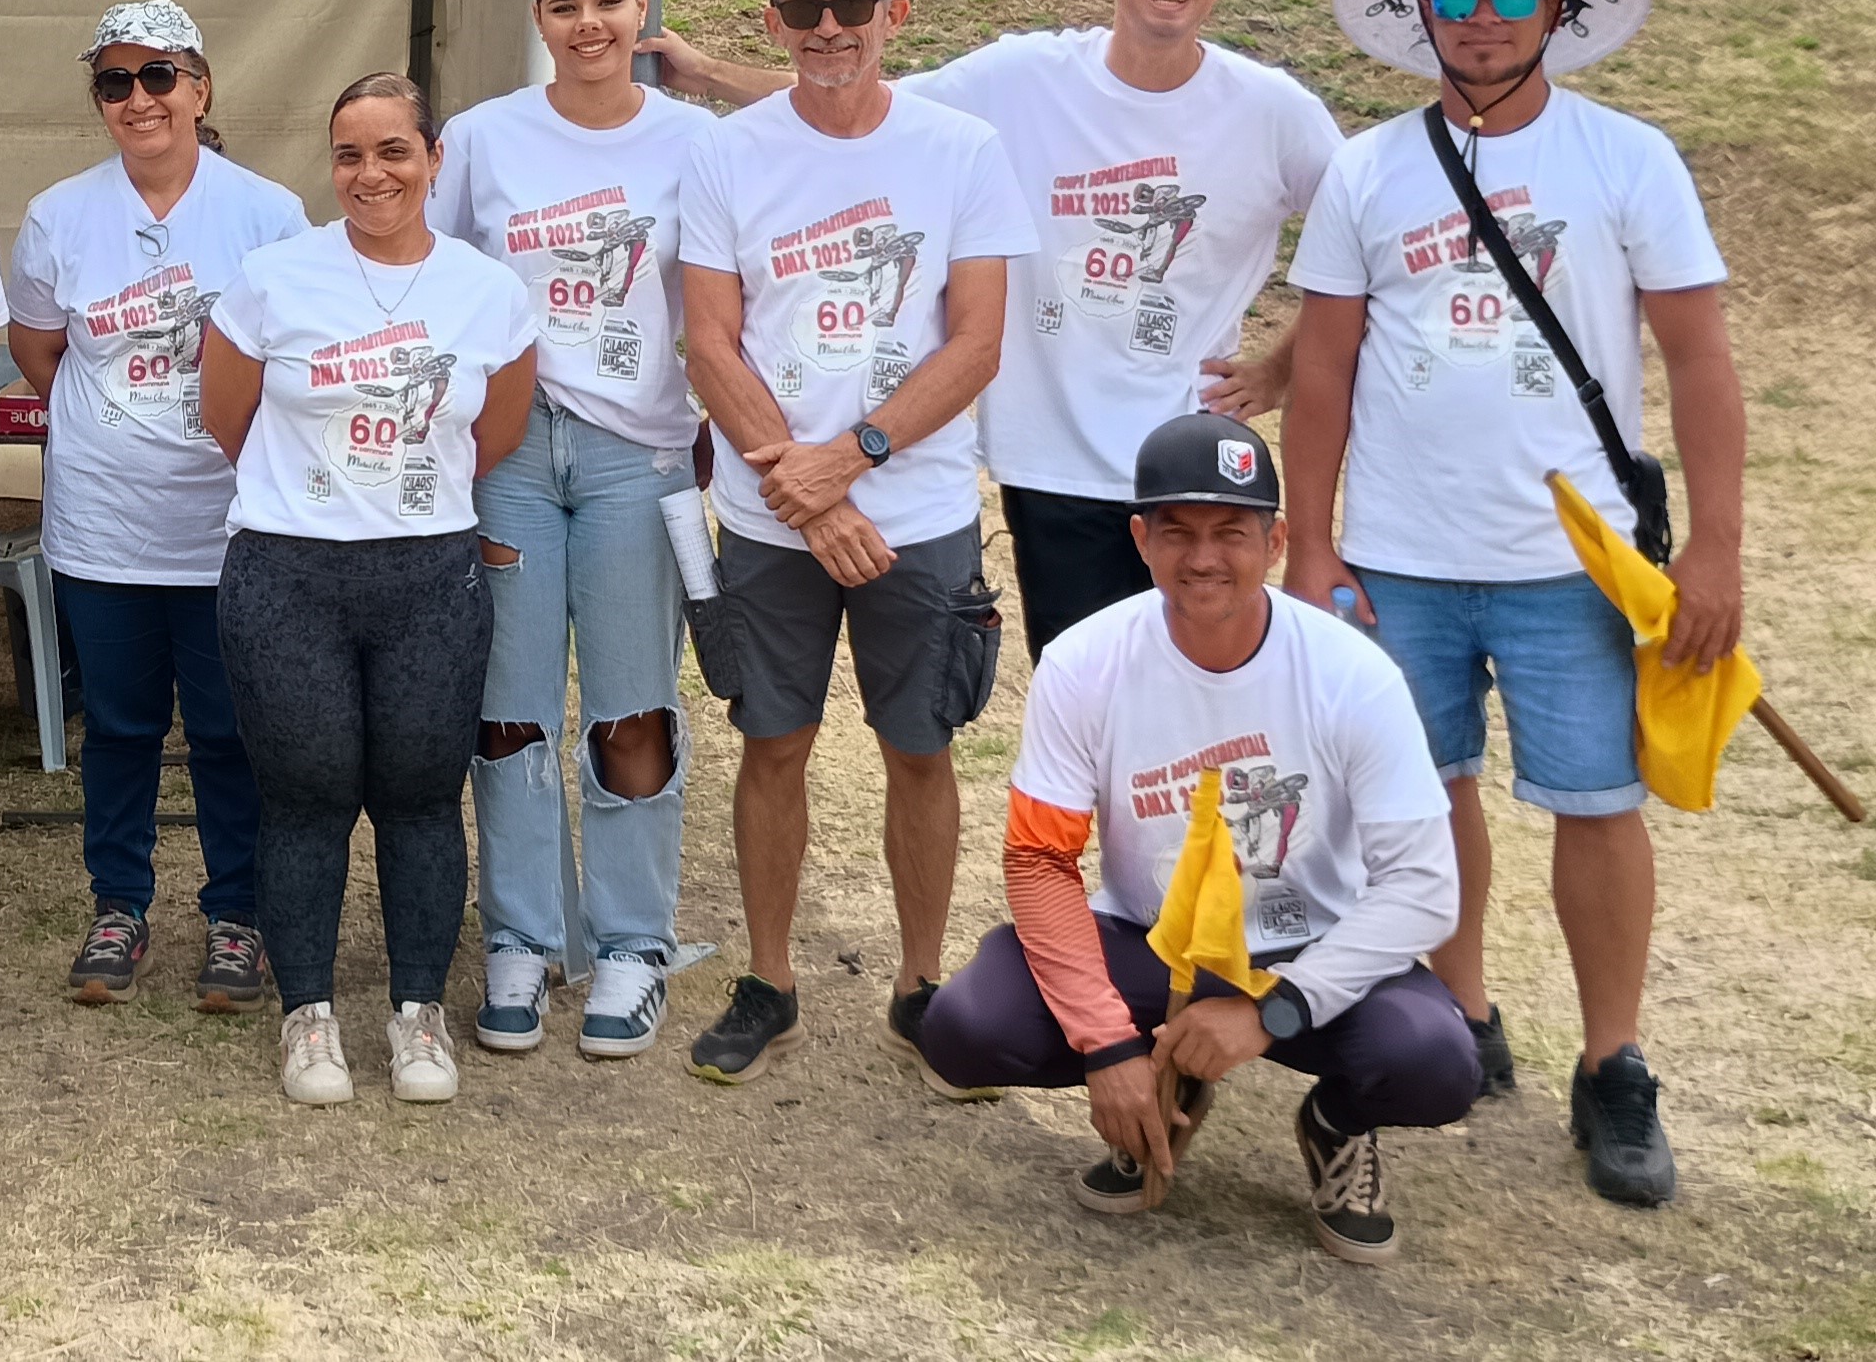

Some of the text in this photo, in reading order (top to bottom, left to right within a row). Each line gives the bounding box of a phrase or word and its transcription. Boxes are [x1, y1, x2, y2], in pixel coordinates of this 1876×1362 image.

[1054, 174, 1086, 189] COUPE
[508, 209, 538, 228] COUPE
[1051, 193, 1131, 216] BMX 2025
[507, 222, 585, 254] BMX 2025
[771, 229, 802, 251] COUPE
[1403, 222, 1434, 246] COUPE
[771, 240, 854, 279] BMX 2025
[1085, 247, 1133, 279] 60
[1404, 242, 1443, 274] BMX
[88, 294, 116, 312] COUPE
[549, 278, 594, 307] 60
[86, 303, 157, 337] BMX 2025
[817, 300, 864, 332] 60
[1450, 293, 1501, 326] 60
[311, 341, 341, 361] COUPE
[128, 355, 170, 381] 60
[310, 357, 389, 387] BMX 2025
[350, 414, 396, 446] 60
[1132, 766, 1168, 789] COUPE
[1132, 789, 1177, 819] BMX
